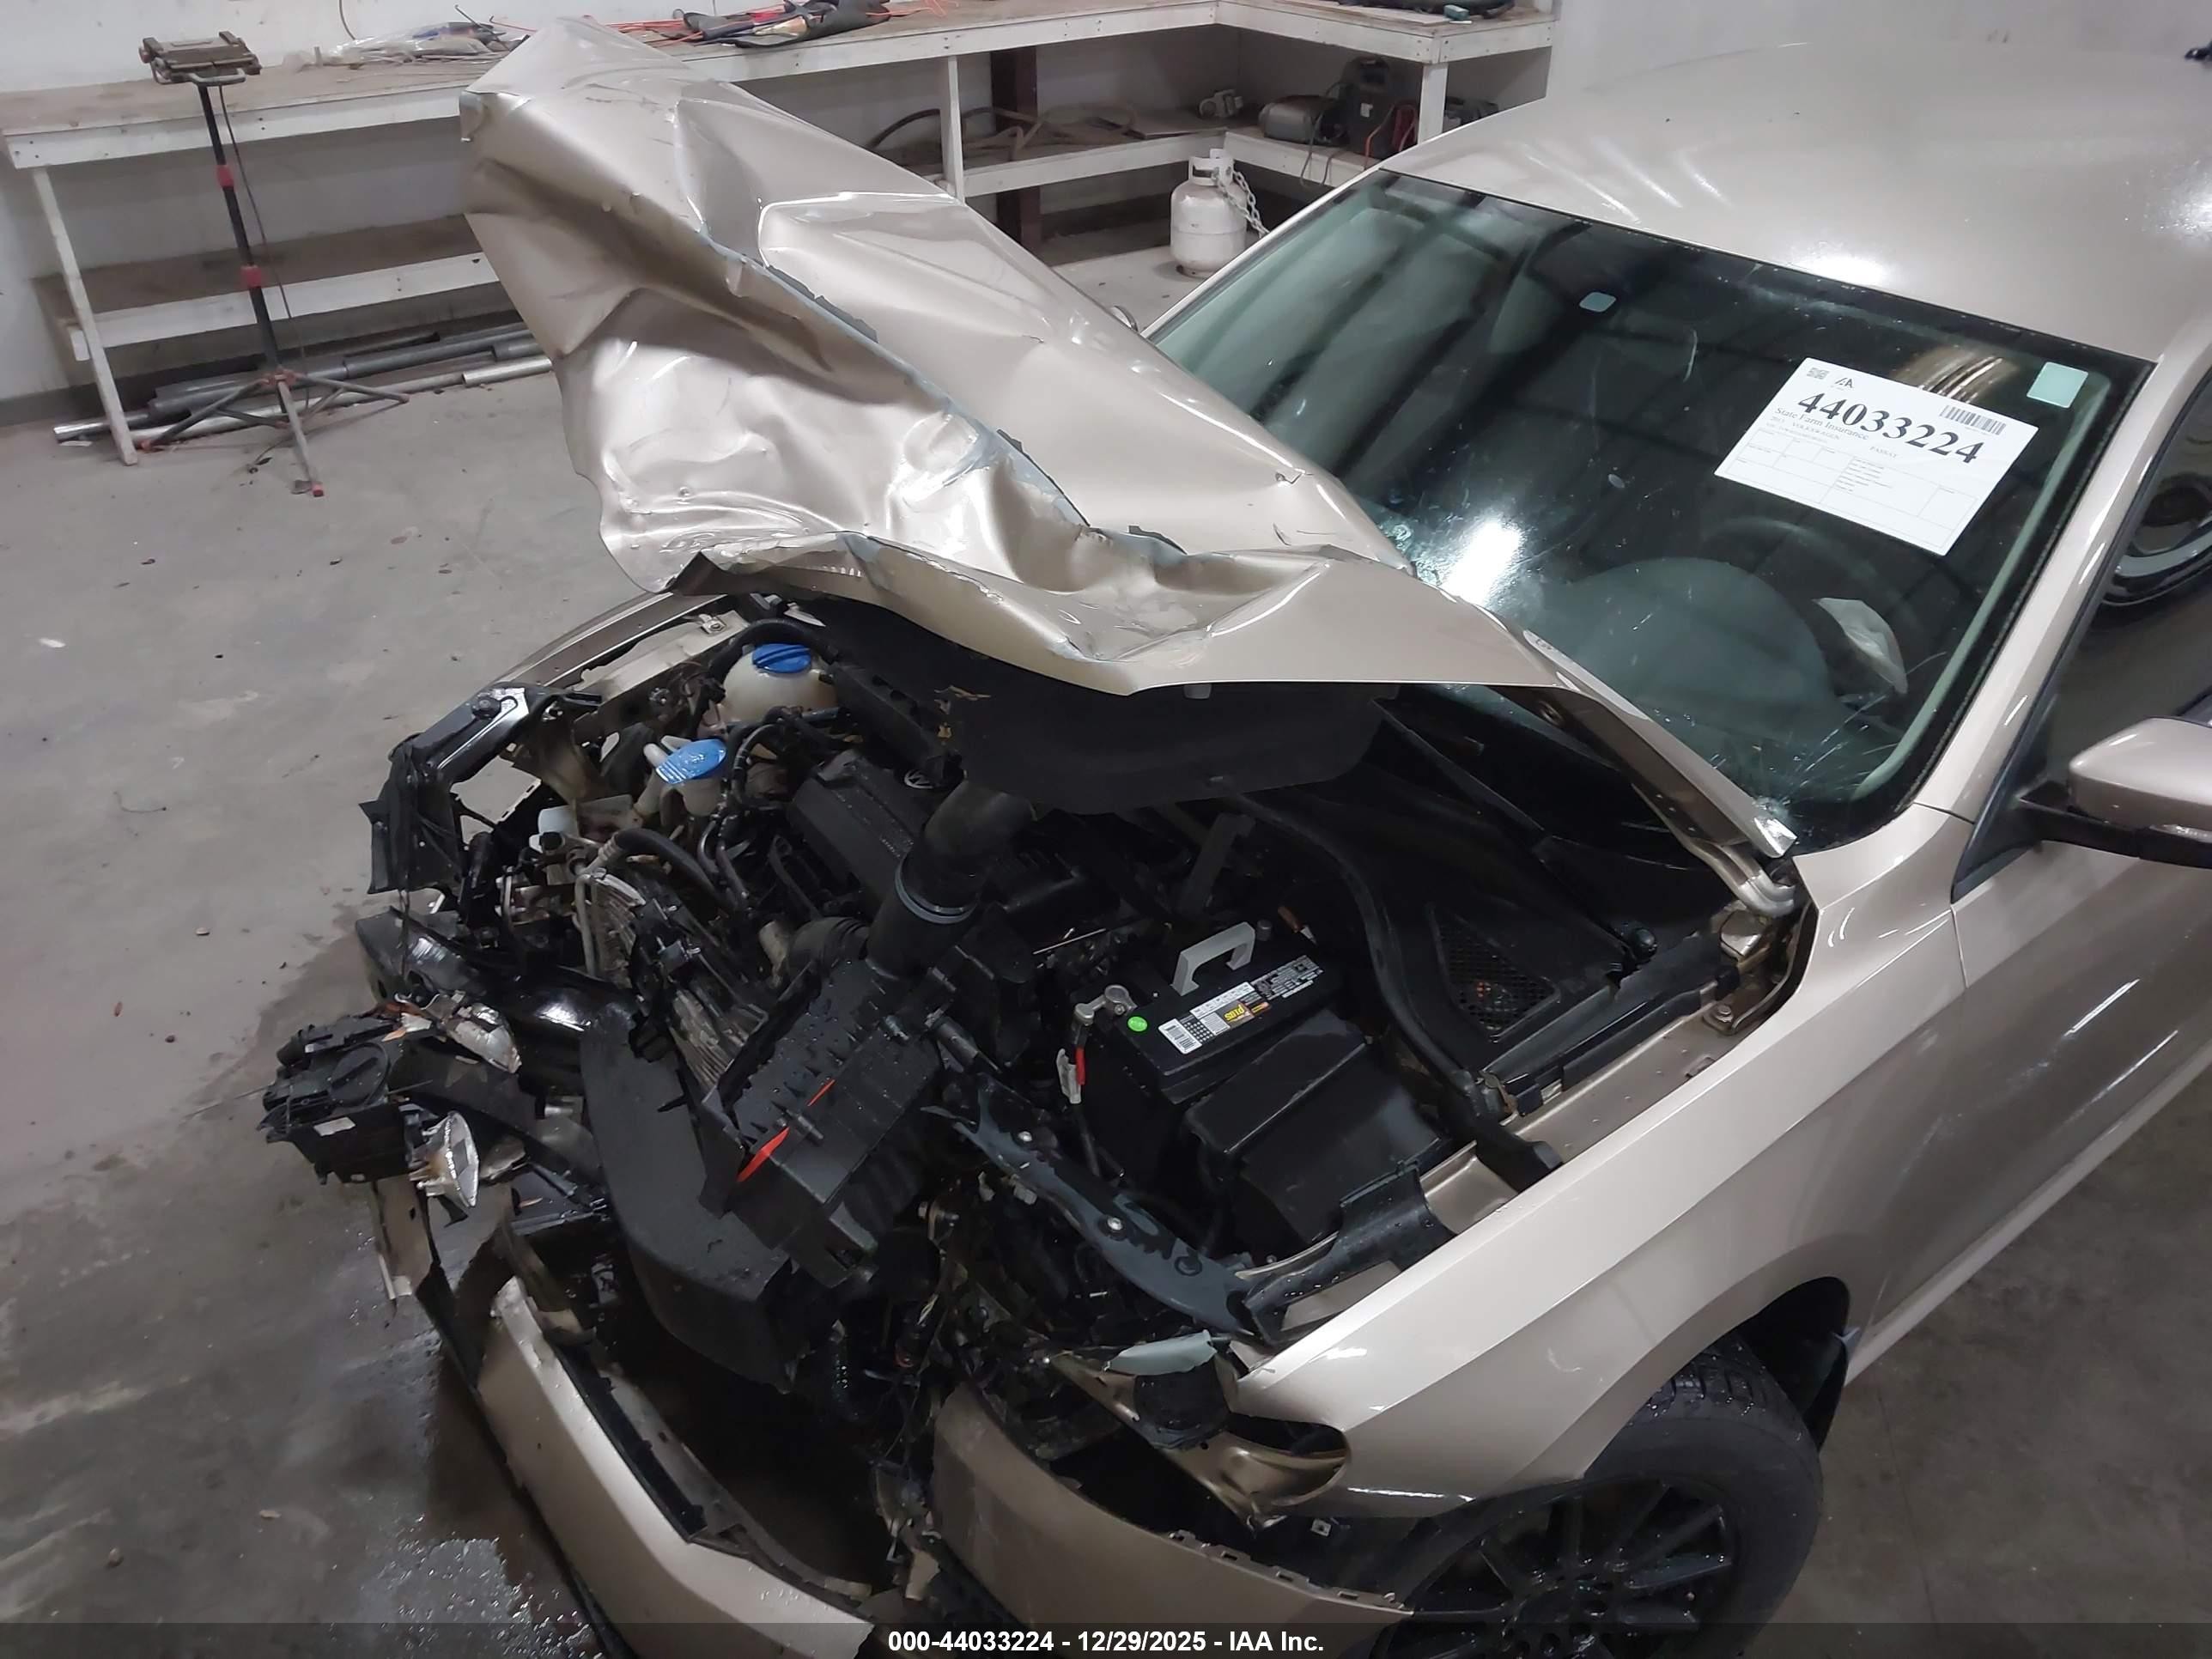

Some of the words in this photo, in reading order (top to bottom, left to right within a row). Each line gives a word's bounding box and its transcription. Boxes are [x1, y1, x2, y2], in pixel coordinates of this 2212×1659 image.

[1776, 407, 1798, 420] State
[1799, 414, 1823, 427] Farm
[1825, 418, 1869, 441] Insurance
[1797, 392, 1984, 464] 44033224
